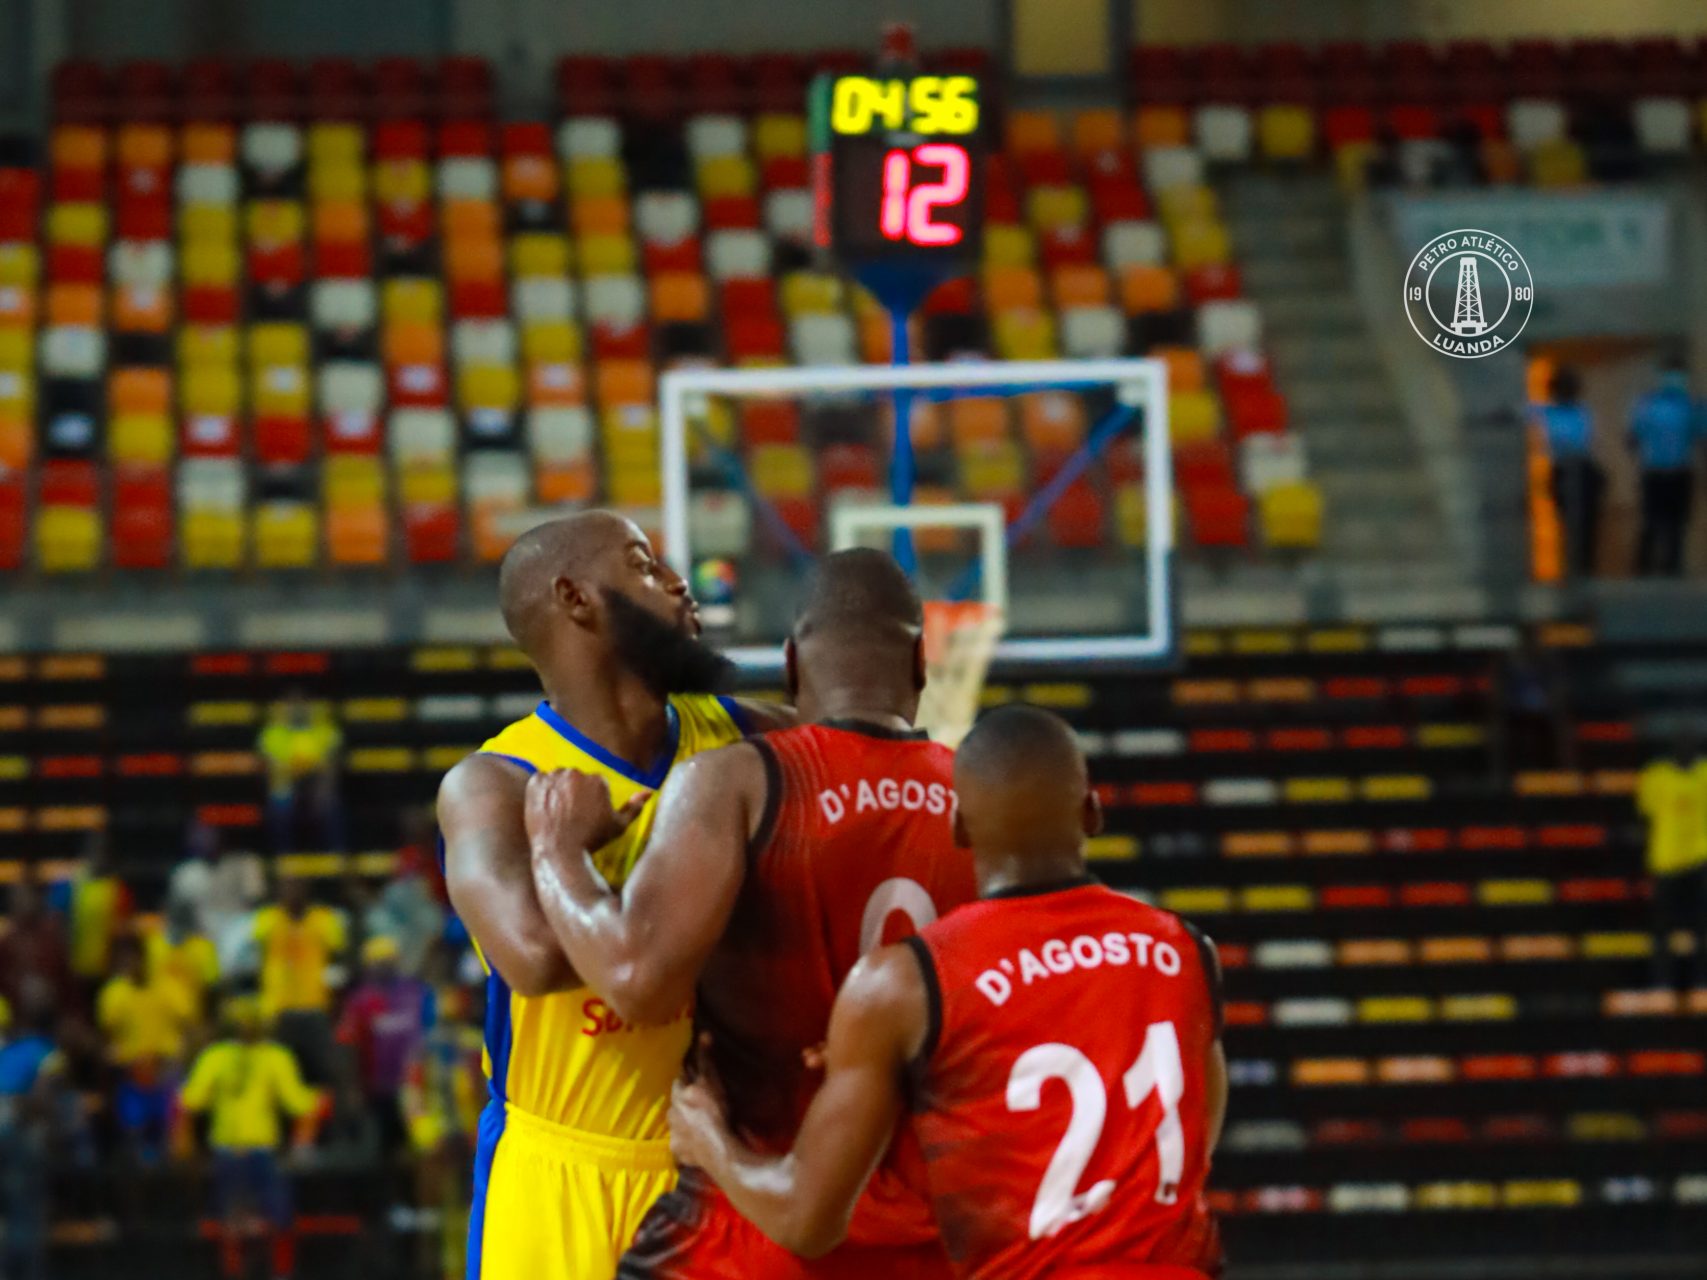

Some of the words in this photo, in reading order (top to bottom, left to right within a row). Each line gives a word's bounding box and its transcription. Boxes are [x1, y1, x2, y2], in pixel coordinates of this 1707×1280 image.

[880, 143, 972, 247] 12
[974, 932, 1182, 1006] D'AGOSTO
[1006, 1020, 1185, 1240] 21
